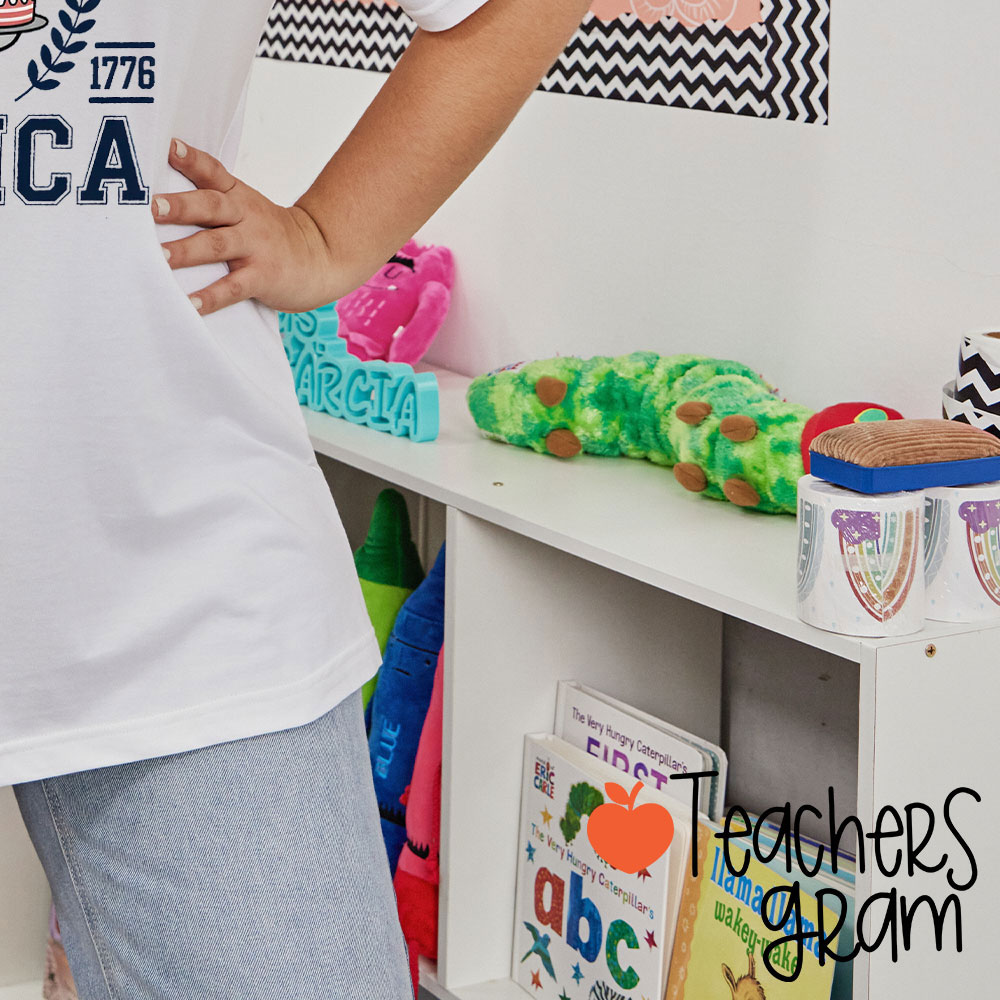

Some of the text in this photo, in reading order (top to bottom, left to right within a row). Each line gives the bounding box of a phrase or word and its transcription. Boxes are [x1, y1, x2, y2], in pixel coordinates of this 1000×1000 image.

[90, 56, 156, 90] 1776
[289, 353, 418, 437] ARCIA
[374, 715, 401, 779] BLUE
[534, 761, 556, 785] ERIC
[572, 706, 688, 775] The Very Hungry Caterpillar's
[533, 775, 555, 800] CARLE
[531, 822, 655, 920] The Very Hungry Caterpillar's
[534, 866, 641, 991] abc
